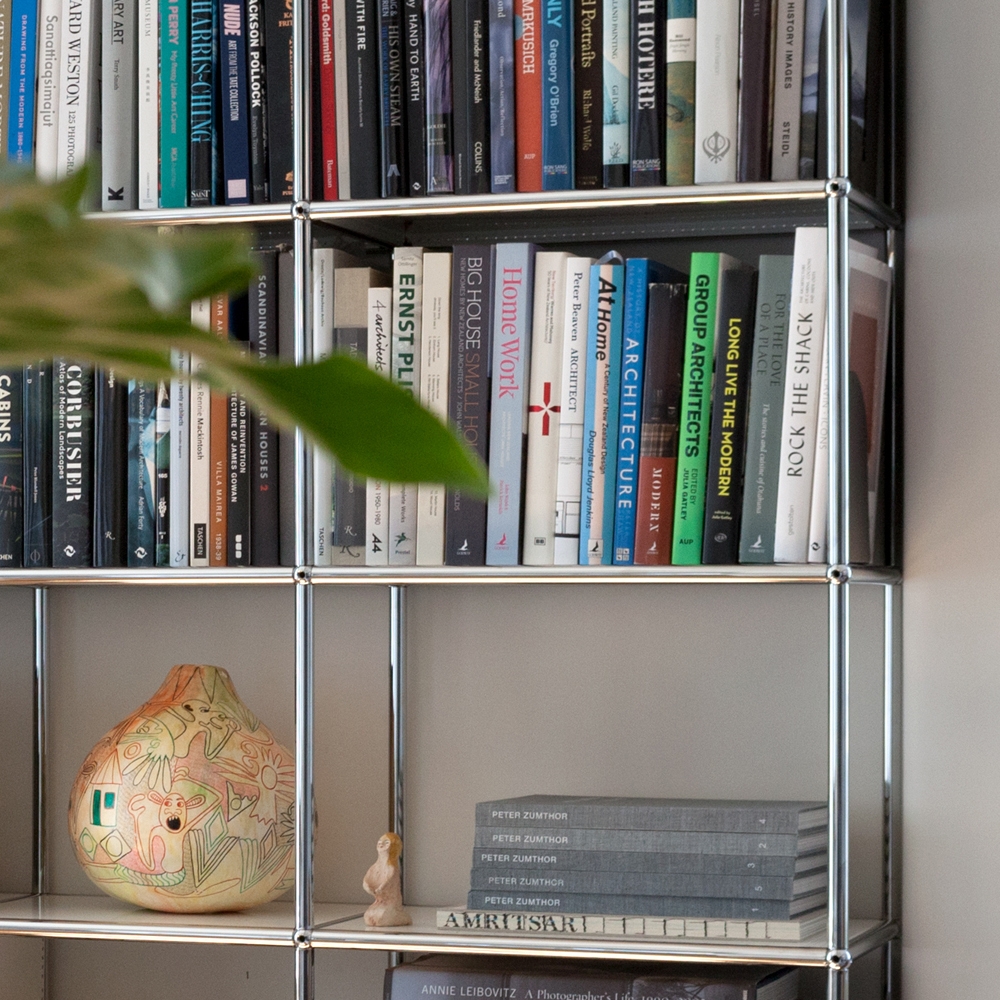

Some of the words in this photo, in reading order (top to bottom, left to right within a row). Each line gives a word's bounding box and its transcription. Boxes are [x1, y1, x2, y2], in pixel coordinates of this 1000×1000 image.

[20, 14, 28, 51] DRAWING
[114, 21, 123, 44] ART
[169, 6, 179, 45] PERRY
[224, 4, 242, 36] NUDE
[357, 25, 366, 50] FIRE
[388, 25, 399, 47] HIS
[408, 14, 418, 46] HAND
[473, 20, 481, 57] Friedlander
[522, 0, 534, 74] MRKUSICH
[580, 9, 596, 68] Portraits
[786, 2, 795, 46] HISTORY
[321, 14, 331, 65] Goldsmith
[409, 49, 419, 64] TO
[40, 15, 58, 127] Sanattiaqsimajut
[66, 37, 81, 106] WESTON
[250, 51, 260, 107] POLLOCK
[389, 49, 400, 82] OWN
[547, 39, 559, 82] Gregory
[637, 22, 655, 110] HOTERE
[784, 50, 793, 89] IMAGES
[410, 67, 420, 101] EARTH
[474, 73, 482, 103] McNeish
[18, 95, 26, 128] MODERN
[390, 85, 401, 126] STEAM
[549, 85, 560, 126] O'Brien
[474, 141, 482, 173] COLLINS
[782, 121, 791, 157] STEIDL
[467, 257, 483, 285] BIG
[571, 272, 583, 301] Peter
[399, 273, 415, 345] ERNST
[501, 267, 523, 335] Home
[597, 277, 617, 304] At
[692, 274, 710, 339] GROUP
[774, 293, 787, 321] FOR
[466, 290, 482, 349] HOUSE
[571, 303, 582, 341] Beaven
[760, 303, 771, 321] OF
[374, 313, 388, 372] architects
[595, 307, 612, 360] Home
[726, 318, 742, 360] LONG
[772, 323, 785, 349] THE
[794, 313, 813, 374] SHACK
[499, 337, 520, 399] Work
[757, 338, 770, 376] PLACE
[770, 354, 784, 386] LOVE
[465, 353, 480, 412] SMALL
[569, 348, 580, 412] ARCHITECT
[723, 363, 739, 396] LIVE
[59, 397, 67, 428] Modern
[684, 342, 705, 457] ARCHITECTS
[721, 399, 737, 428] THE
[791, 384, 808, 416] THE
[66, 365, 83, 502] CORBUSIER
[196, 418, 204, 461] Mackintosh
[618, 338, 640, 509] ARCHITECTURE
[760, 417, 769, 437] stories
[58, 430, 67, 479] Landscapes
[260, 432, 268, 479] HOUSES
[587, 430, 597, 467] Douglas
[717, 432, 734, 496] MODERN
[787, 426, 805, 477] ROCK
[586, 470, 596, 493] Lloyd
[691, 468, 699, 492] EDITED
[585, 495, 595, 529] Jenkins
[680, 491, 688, 520] GATLEY
[492, 811, 521, 819] PETER
[523, 812, 568, 820] ZUMTHOR
[492, 834, 521, 843] PETER
[524, 835, 568, 844] ZUMTHOR
[481, 854, 510, 862] PETER
[512, 855, 557, 863] ZUMTHOR
[488, 877, 517, 885] PETER
[519, 878, 564, 886] ZUMTHOR
[485, 897, 513, 905] PETER
[516, 898, 560, 907] ZUMTHOR
[421, 984, 456, 996] ANNIE
[460, 986, 517, 998] LEIBOVITZ
